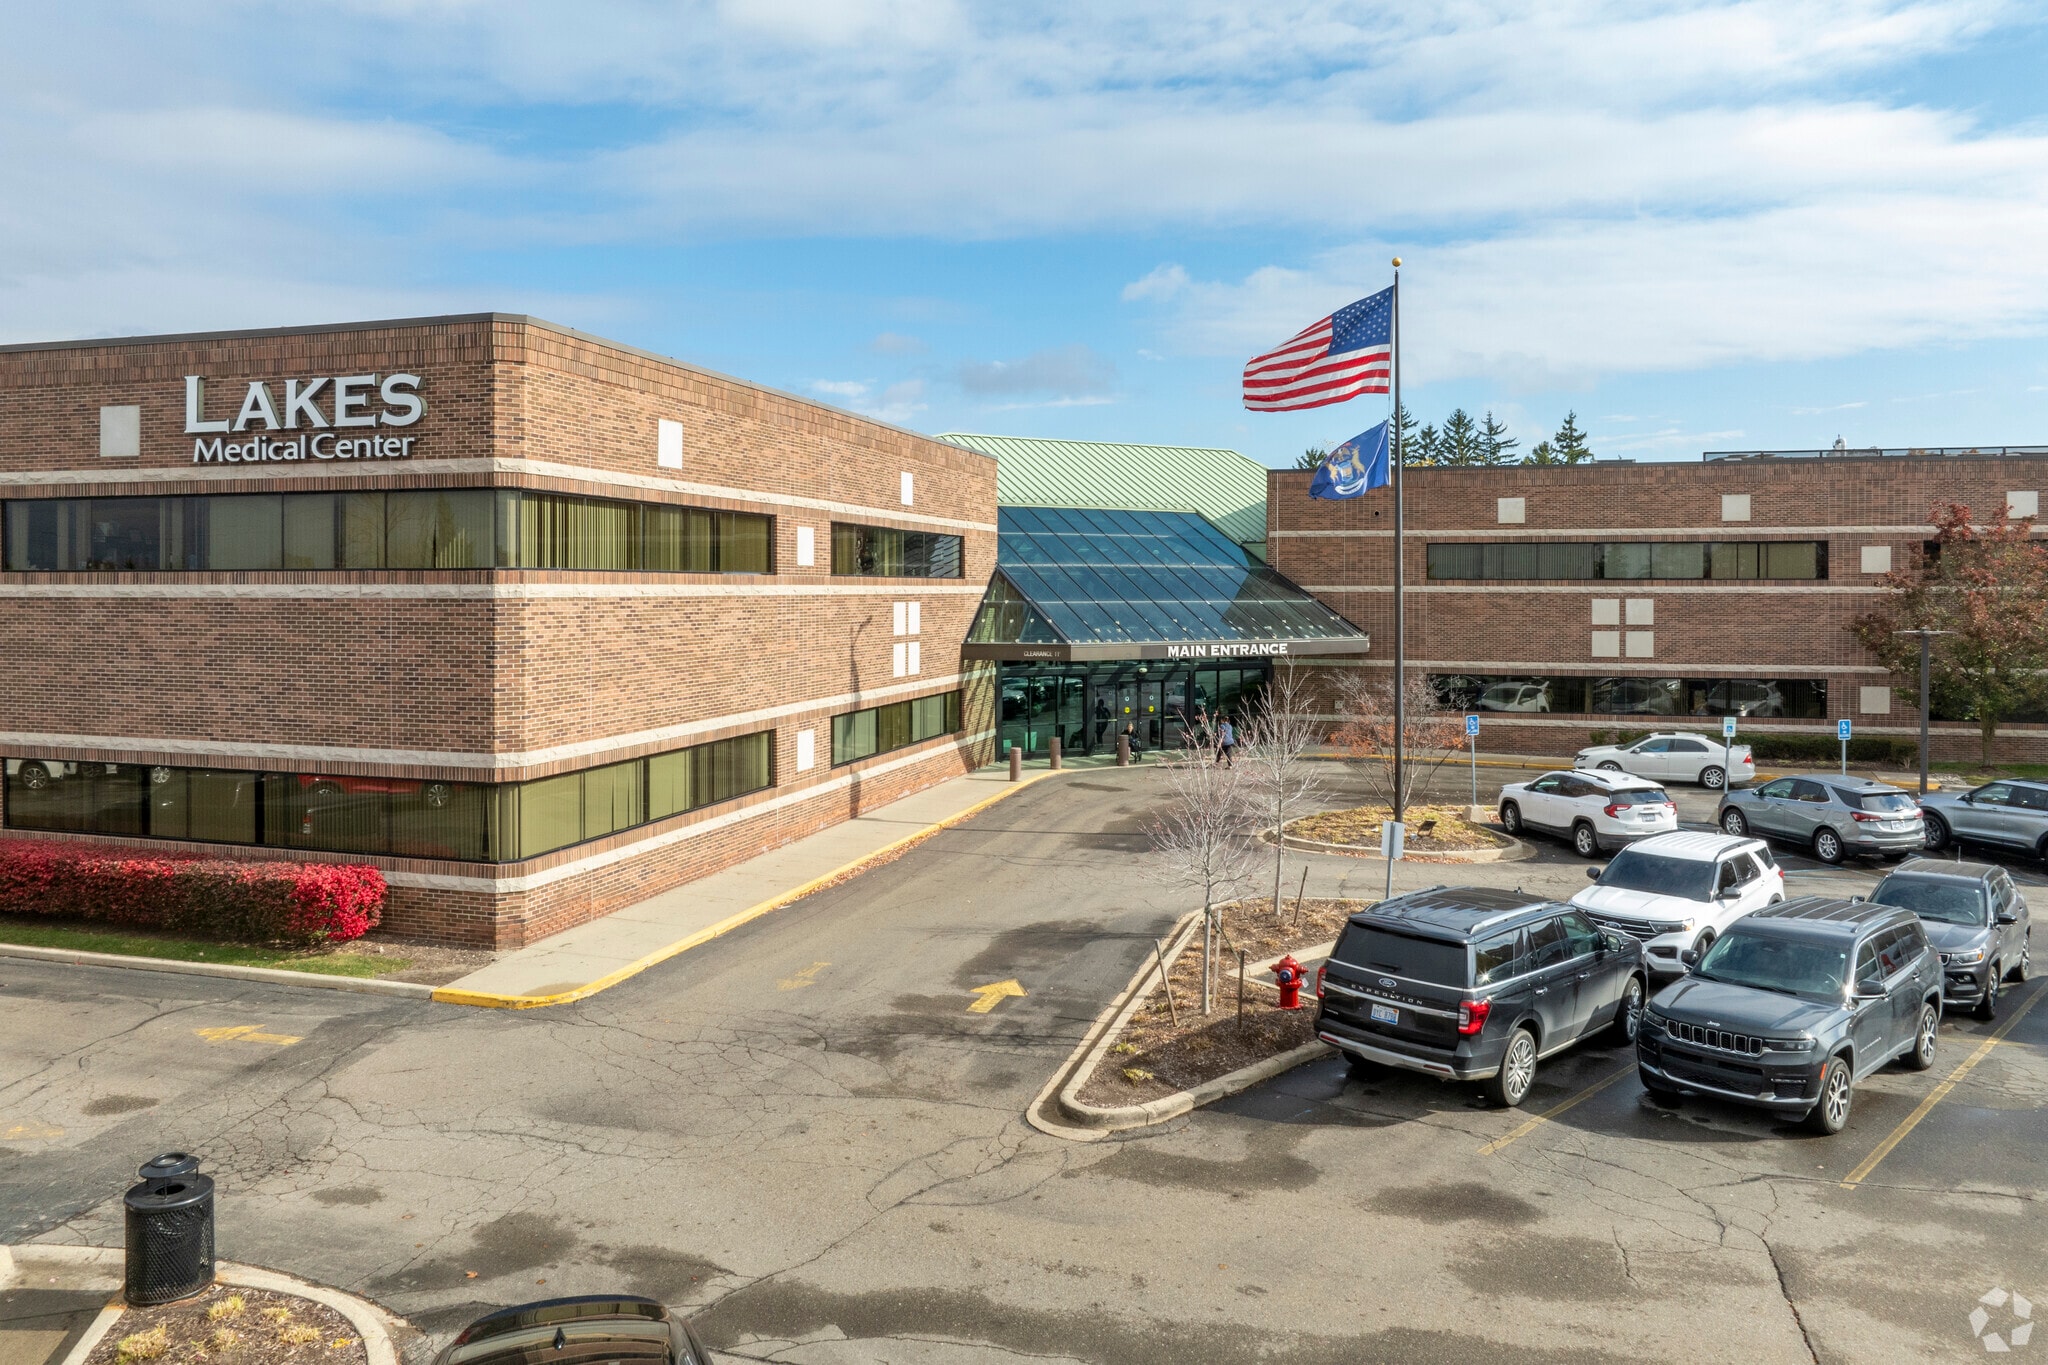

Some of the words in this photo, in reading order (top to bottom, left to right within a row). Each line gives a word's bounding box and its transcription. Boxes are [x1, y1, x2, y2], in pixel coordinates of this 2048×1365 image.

[184, 373, 427, 434] LAKES
[193, 435, 305, 462] Medical
[311, 433, 415, 459] Center
[1167, 645, 1206, 658] MAIN
[1210, 643, 1288, 656] ENTRANCE
[1351, 984, 1423, 1005] EXPEDITION
